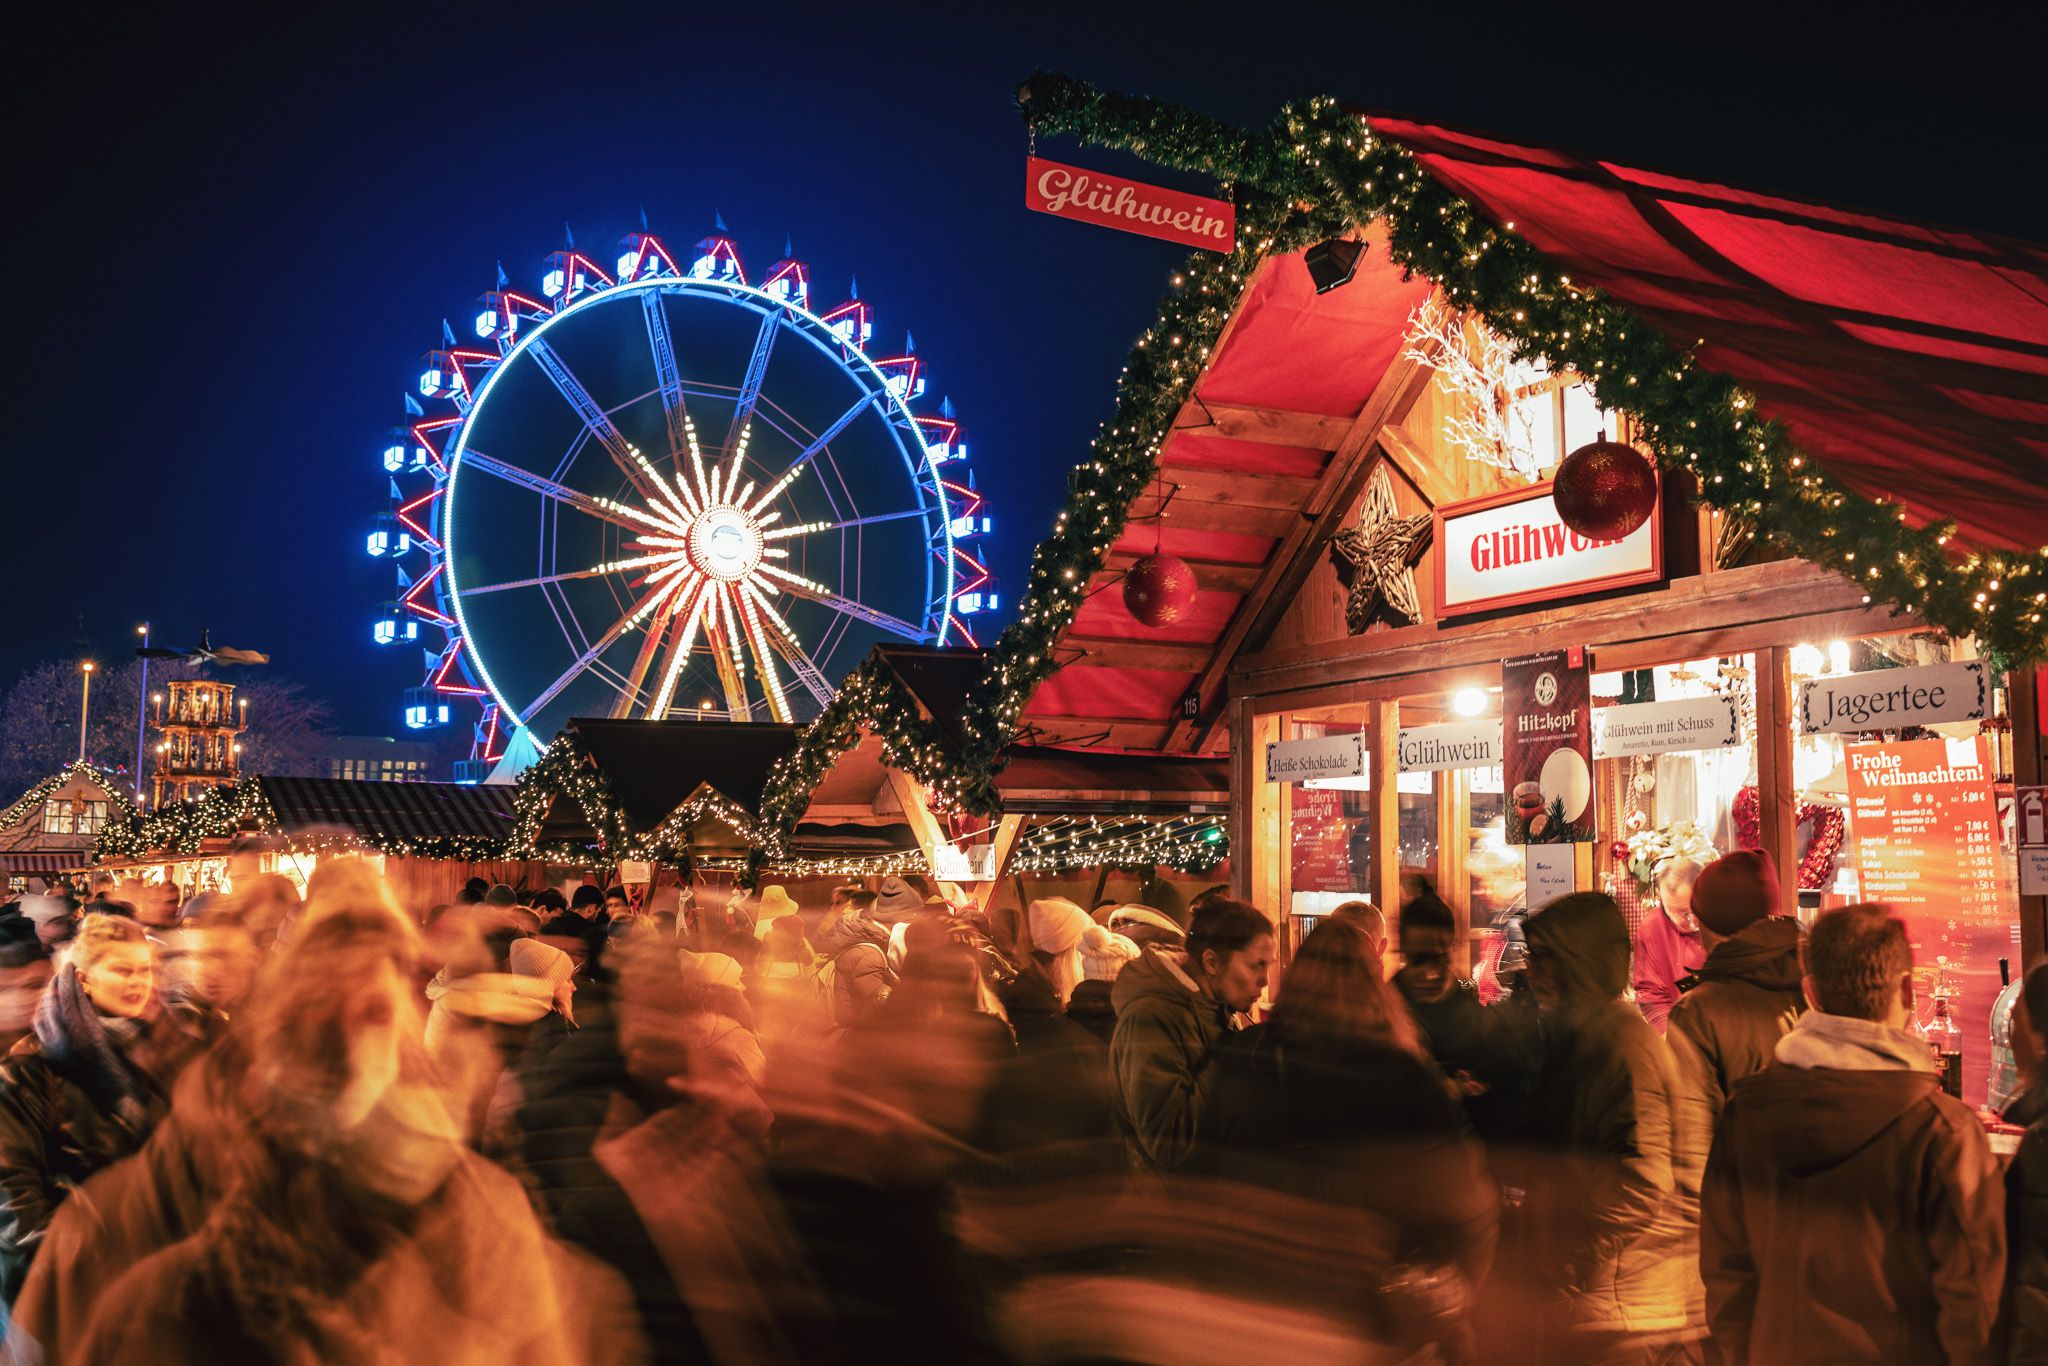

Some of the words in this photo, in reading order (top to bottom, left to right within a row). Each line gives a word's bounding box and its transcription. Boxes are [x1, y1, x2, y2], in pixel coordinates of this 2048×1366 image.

[1038, 169, 1228, 239] Glühwein
[1184, 698, 1197, 715] 115
[1822, 684, 1946, 727] Jagertee
[1518, 709, 1577, 732] Hitzkopf
[1603, 721, 1653, 738] Glühwein
[1656, 719, 1674, 733] mit
[1677, 716, 1715, 731] Schuss
[1651, 738, 1667, 748] Rum,
[1668, 736, 1687, 745] Kirsch
[1404, 735, 1490, 766] Glühwein
[1274, 757, 1298, 773] Heiße
[1299, 753, 1348, 771] Schokolade
[1852, 751, 1902, 771] Frohe
[1861, 763, 1985, 788] Weihnachten!
[1962, 791, 1979, 803] 5,00
[1979, 791, 1986, 801] €
[1982, 820, 1989, 830] €
[1967, 832, 1984, 843] 6,00
[1984, 832, 1990, 842] €
[1985, 845, 1992, 854] €
[1987, 856, 1993, 866] €
[1988, 868, 1995, 878] €
[1990, 881, 1996, 889] €
[1991, 893, 1998, 902] €
[1992, 904, 1999, 914] €
